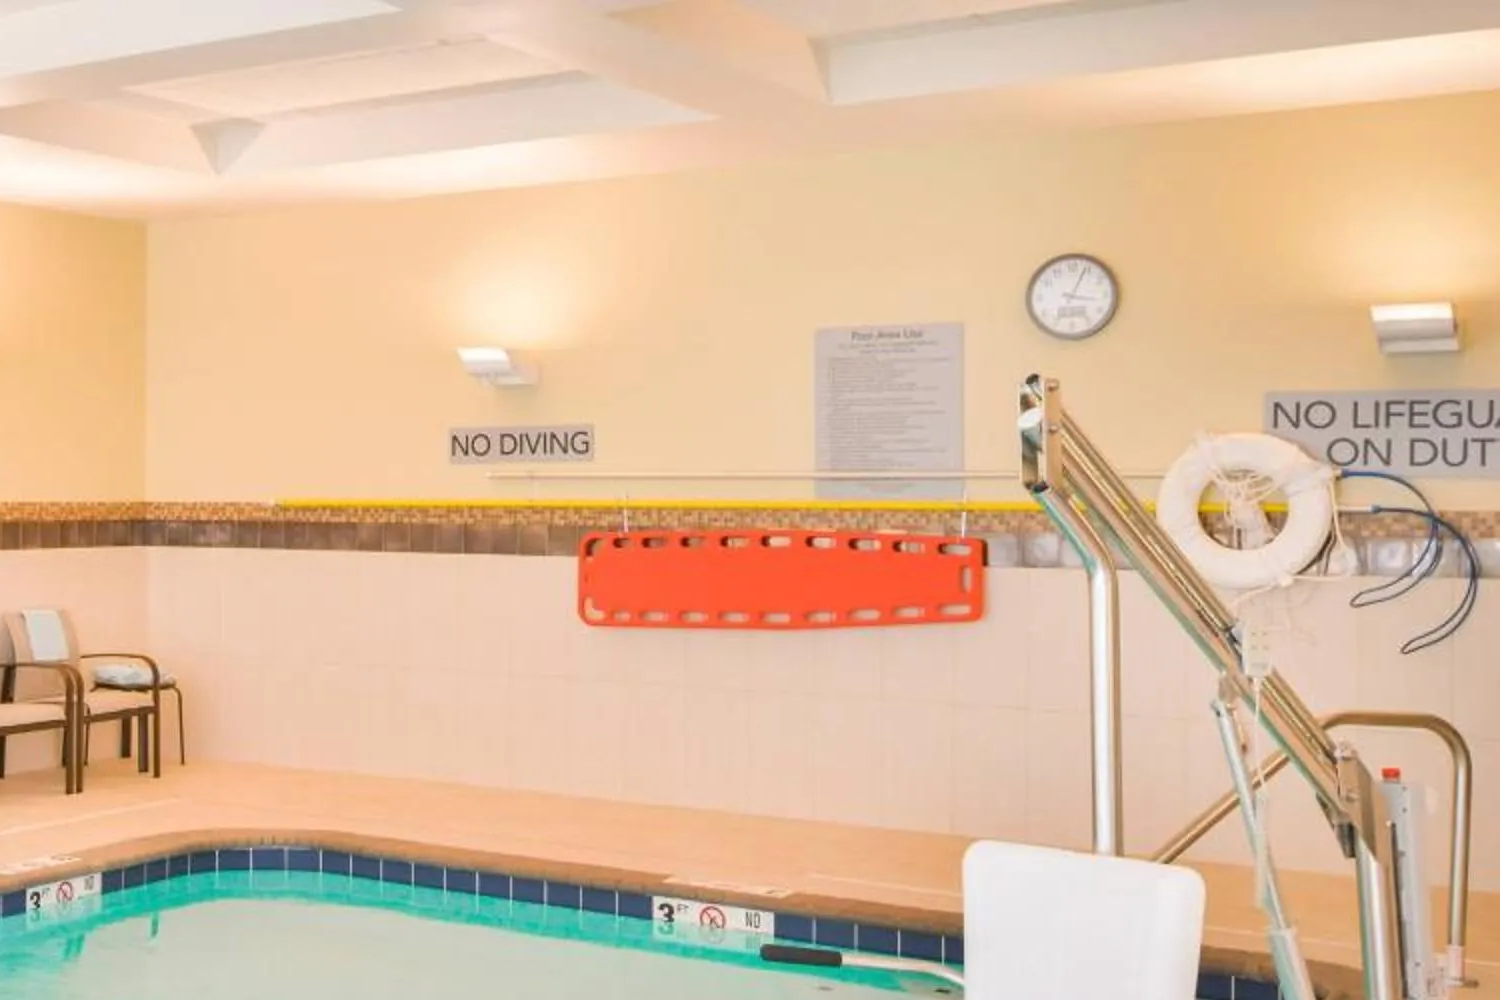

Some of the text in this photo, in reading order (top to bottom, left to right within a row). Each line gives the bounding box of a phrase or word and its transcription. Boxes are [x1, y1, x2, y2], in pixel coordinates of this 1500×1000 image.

[1272, 399, 1500, 429] NO LIFEGU
[451, 431, 589, 456] NO DIVING
[1327, 437, 1497, 467] ON DUT
[658, 903, 674, 923] 3
[745, 911, 761, 929] NO
